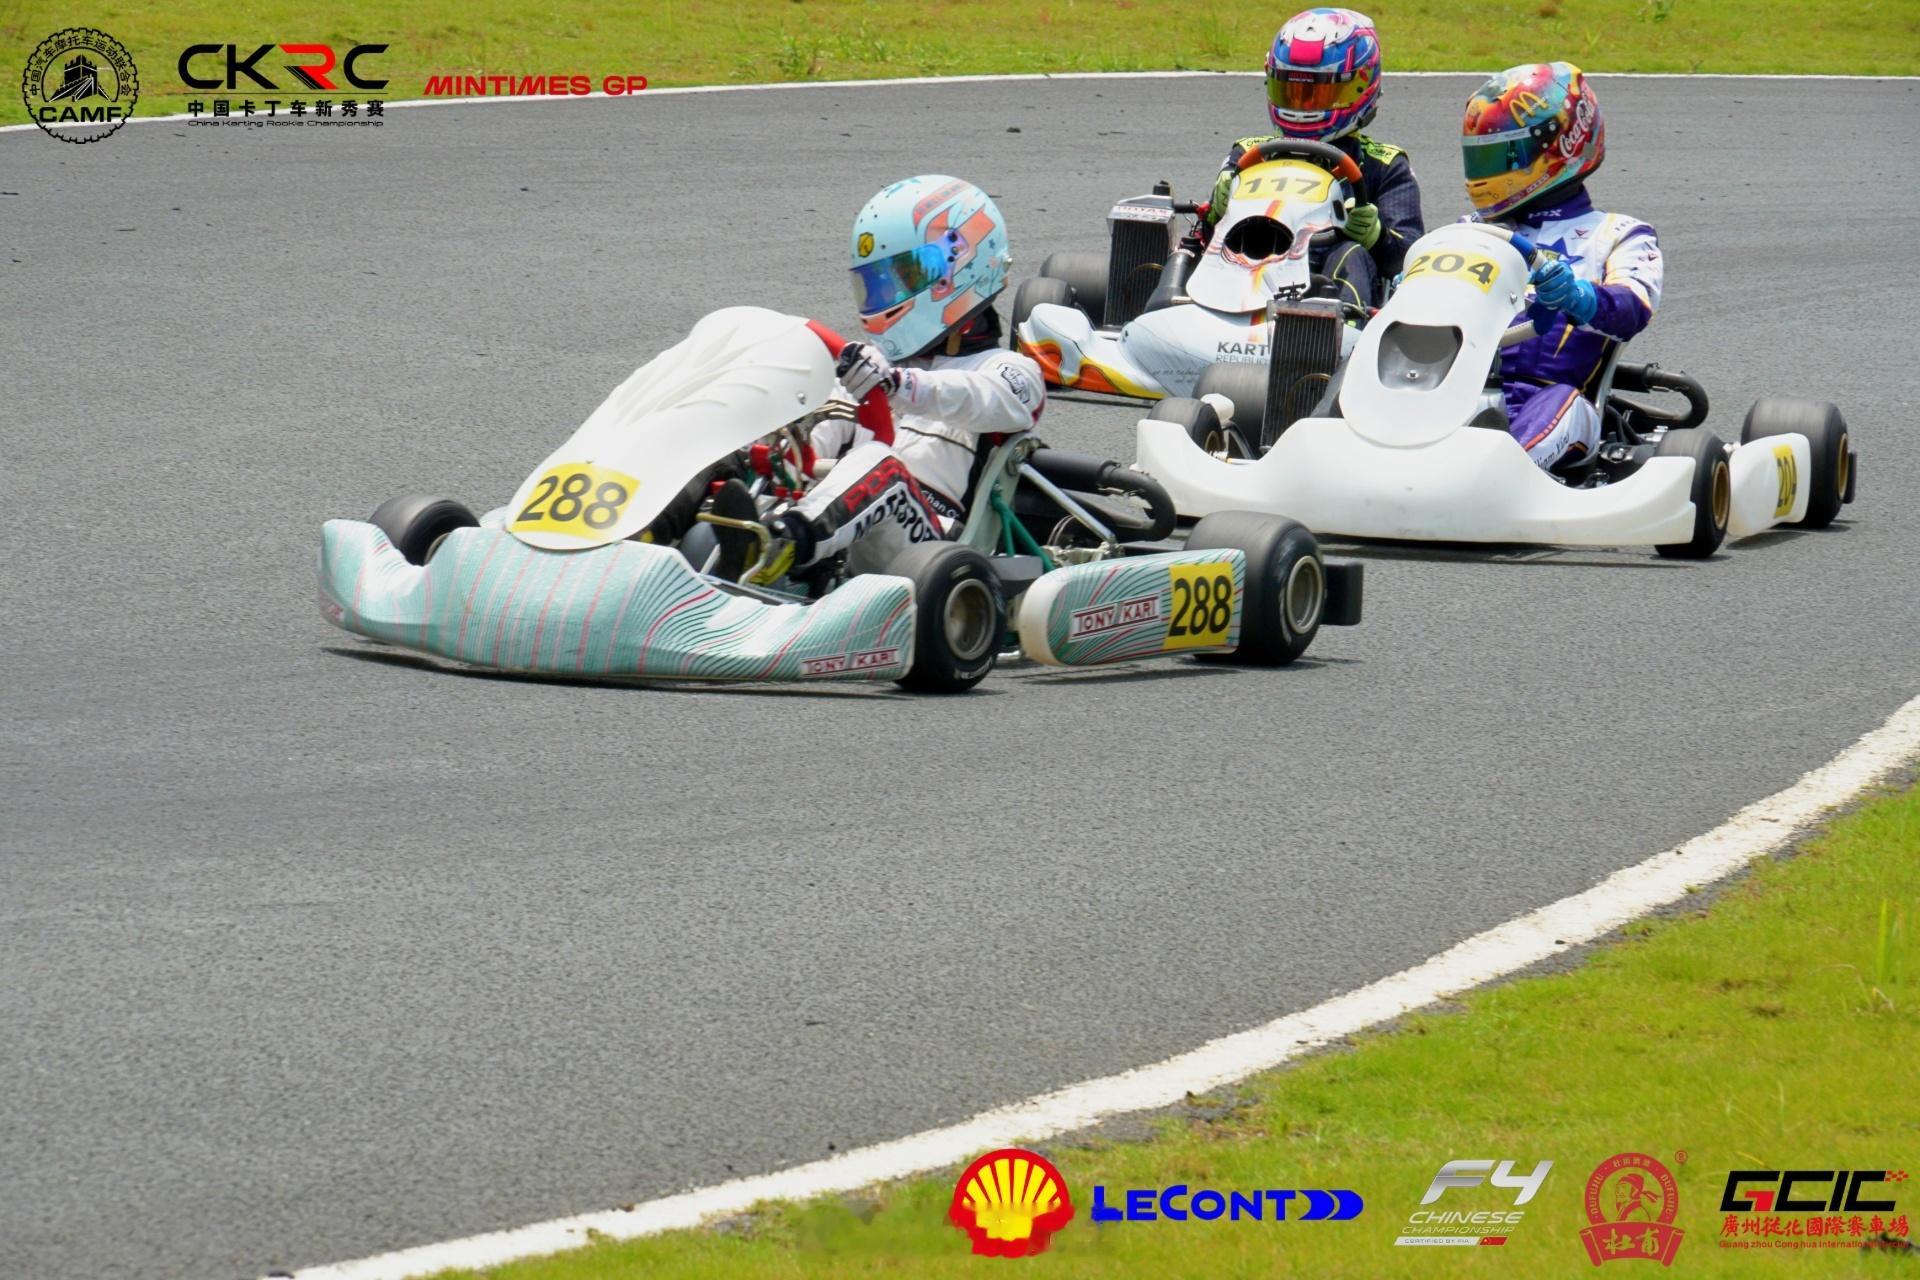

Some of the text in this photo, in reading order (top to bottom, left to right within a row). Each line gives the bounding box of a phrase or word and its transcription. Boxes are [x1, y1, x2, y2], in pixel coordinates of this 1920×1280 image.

[1244, 177, 1321, 195] 117
[1406, 254, 1495, 285] 204
[1217, 341, 1270, 357] KART
[516, 473, 628, 530] 288
[1077, 599, 1158, 632] TONY KART
[1168, 574, 1233, 637] 288
